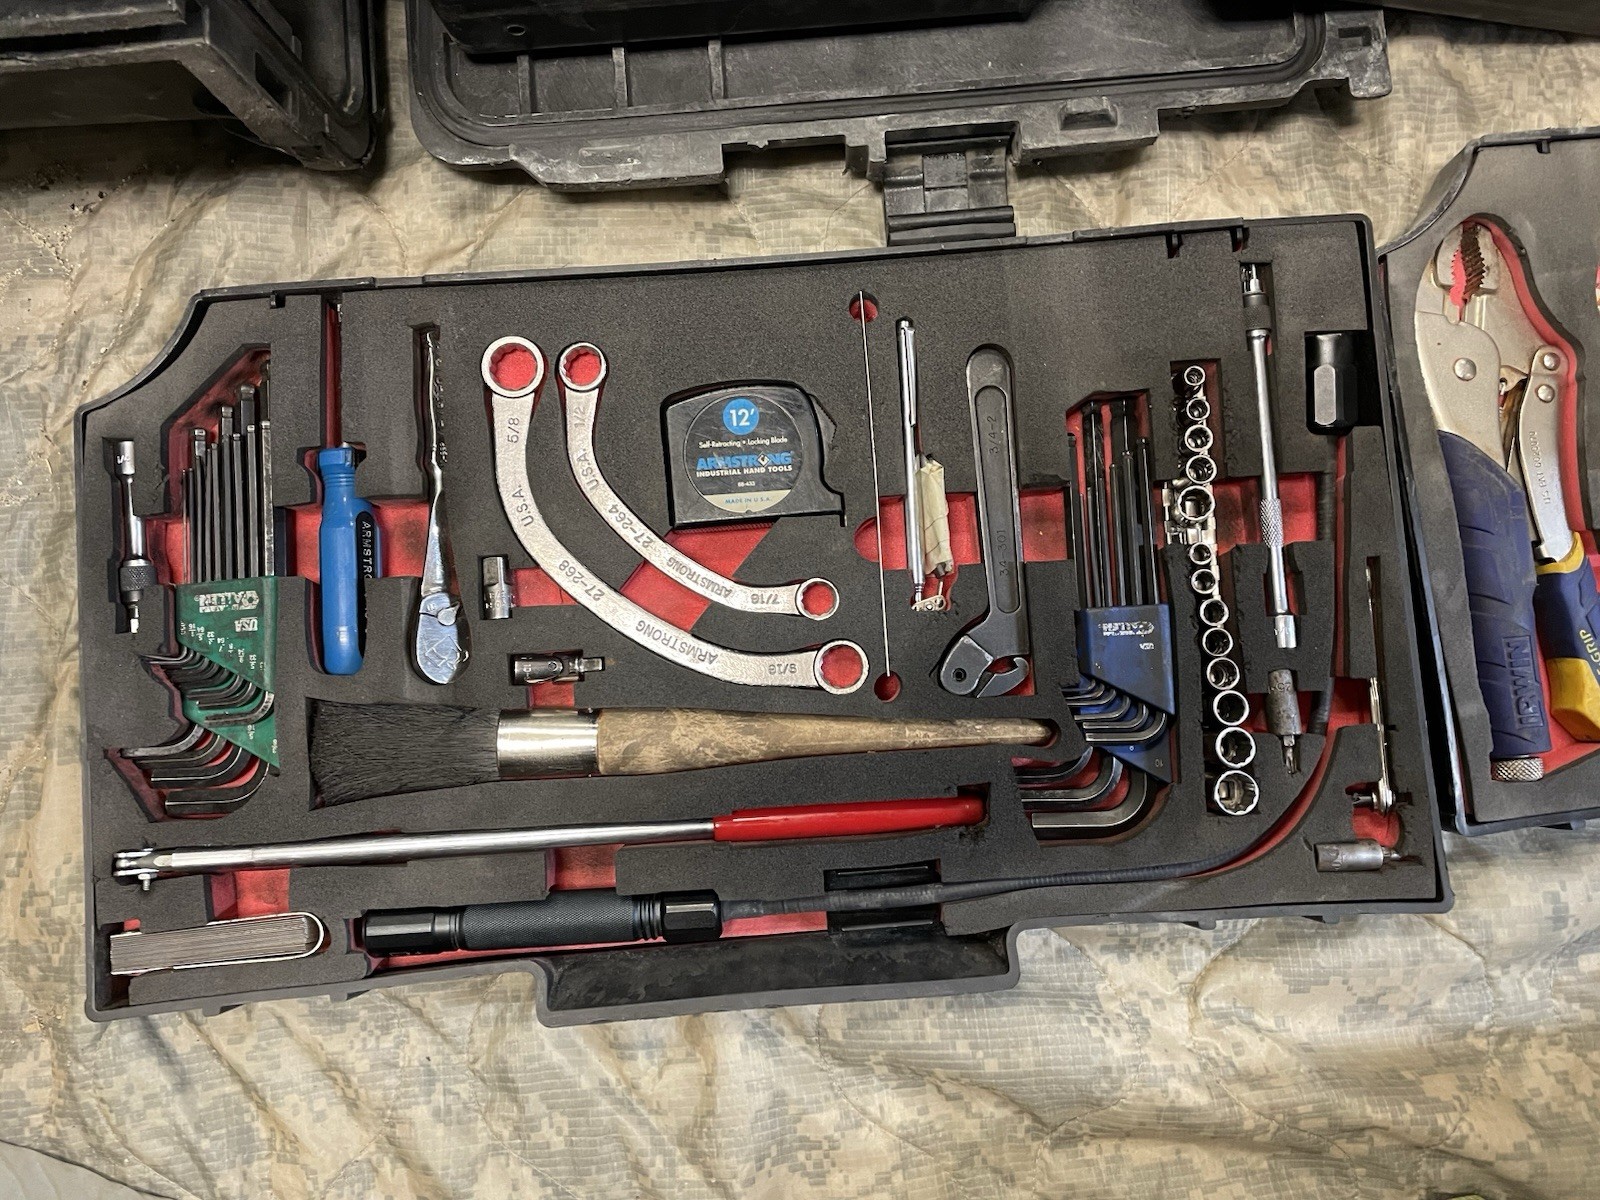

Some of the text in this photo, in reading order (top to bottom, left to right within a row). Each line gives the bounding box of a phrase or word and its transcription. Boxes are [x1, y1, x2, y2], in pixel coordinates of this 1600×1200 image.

[506, 416, 521, 445] 5/8
[574, 405, 586, 431] 1/2
[748, 438, 769, 448] Locking
[771, 436, 787, 444] Blade
[696, 465, 792, 478] INDUSTRIAL HAND TOOLS
[609, 502, 655, 548] 27-264
[556, 559, 606, 603] 27-268
[666, 556, 734, 599] ARMSTRONG
[635, 619, 719, 666] ARMSTRONG
[1507, 639, 1543, 727] IRWIN
